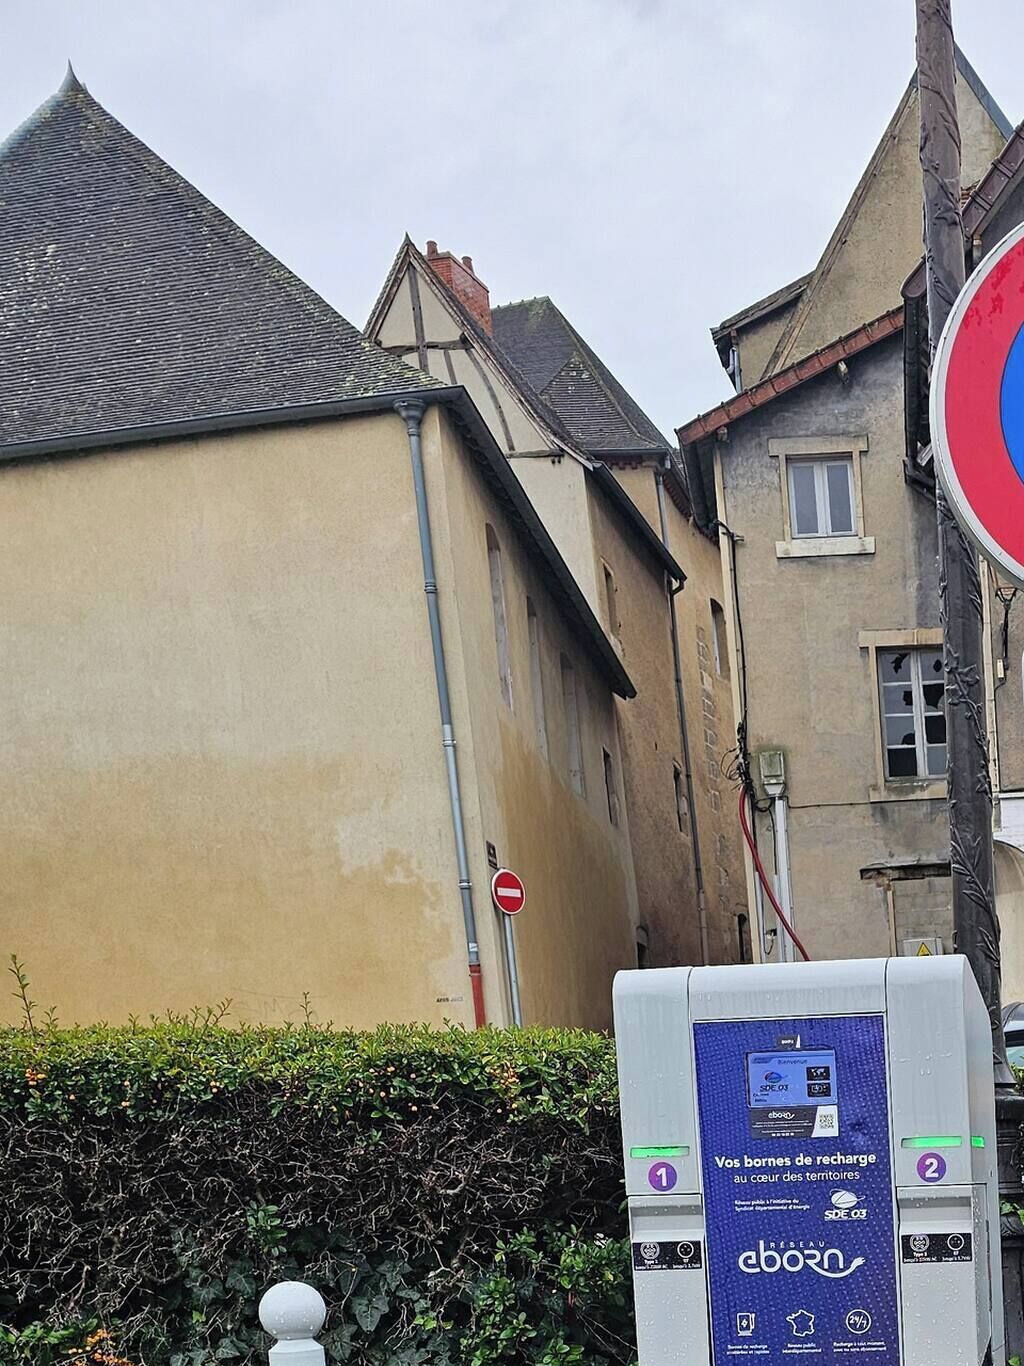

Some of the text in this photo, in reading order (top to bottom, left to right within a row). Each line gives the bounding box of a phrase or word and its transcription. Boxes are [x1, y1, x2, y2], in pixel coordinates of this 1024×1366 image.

[760, 1084, 777, 1092] SDE
[714, 1152, 877, 1168] Vos bornes de recharge
[925, 1157, 939, 1178] 2
[655, 1167, 667, 1187] 1
[734, 1171, 860, 1183] au cœur des territoires
[824, 1208, 867, 1219] SDE 03
[849, 1315, 867, 1329] 24/7
